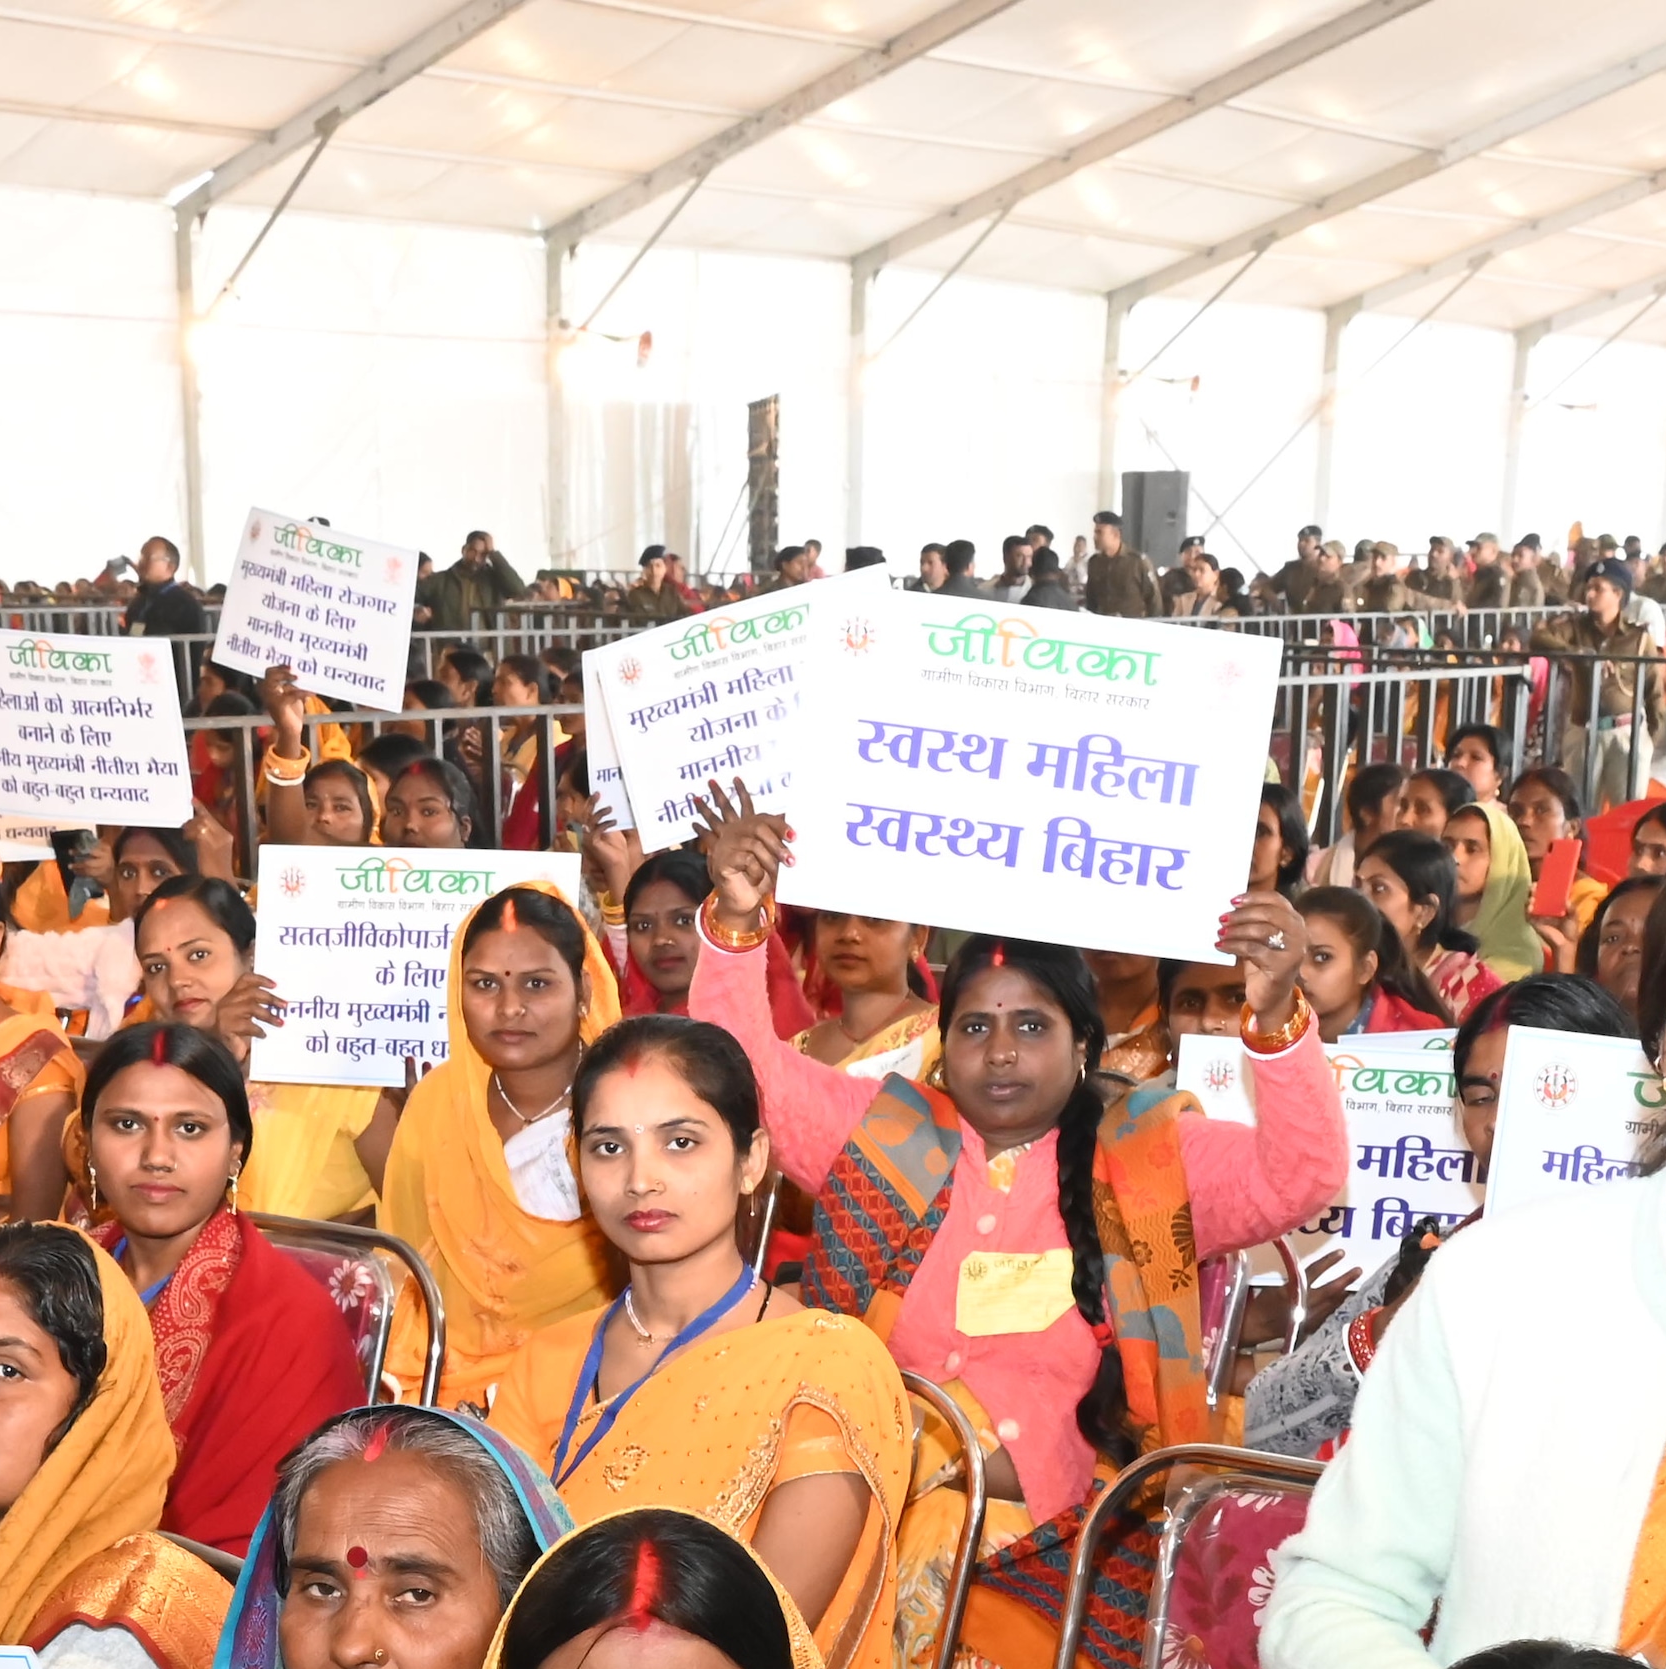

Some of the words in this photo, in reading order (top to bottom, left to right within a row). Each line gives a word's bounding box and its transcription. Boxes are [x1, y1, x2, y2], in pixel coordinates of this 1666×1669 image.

[921, 615, 1163, 687] जीविका
[628, 682, 718, 728] मुख्यमंत्री
[727, 665, 793, 695] महिला
[857, 719, 1009, 780] स्वस्थ
[1026, 733, 1200, 807] महिला
[335, 858, 495, 895] जीविका
[1042, 816, 1191, 891] बिहार
[375, 960, 396, 986] के
[405, 961, 446, 989] लिए
[346, 1000, 431, 1025] मुख्यमंत्री
[305, 1030, 329, 1054] को
